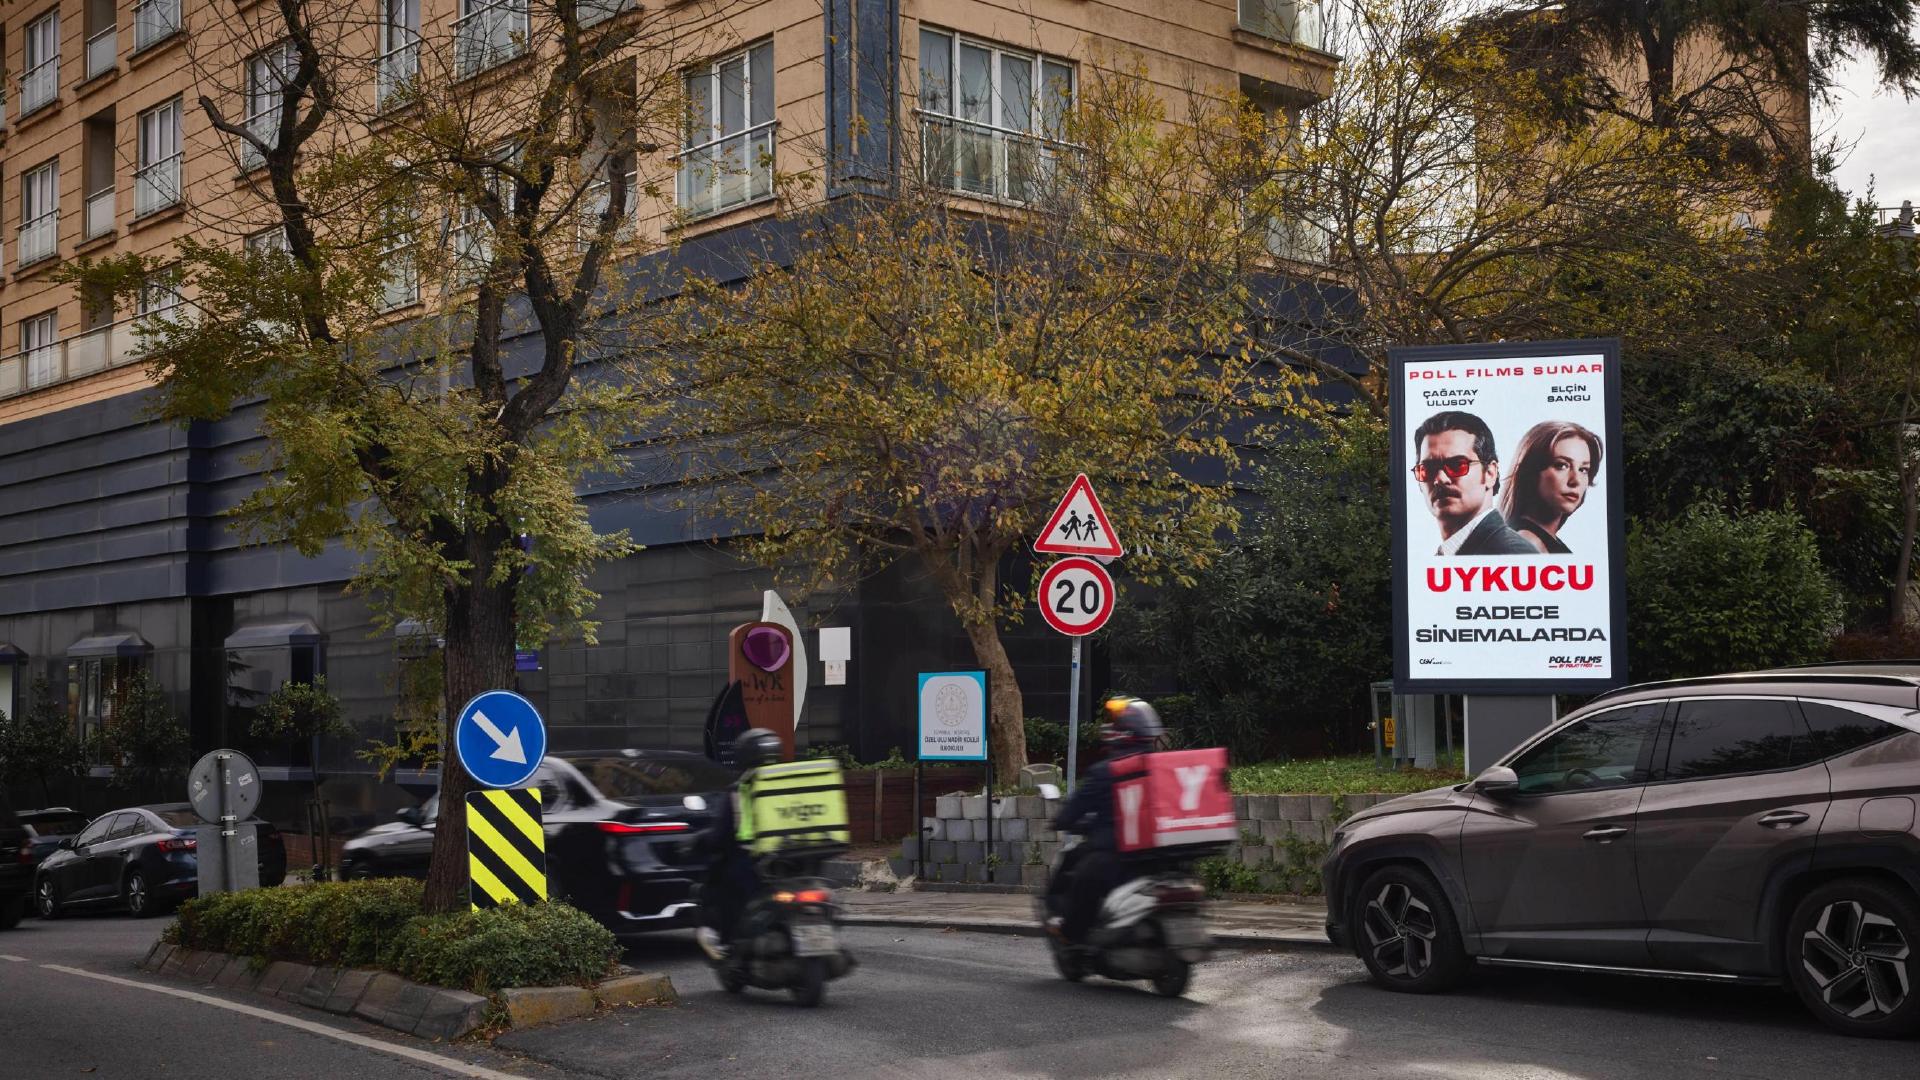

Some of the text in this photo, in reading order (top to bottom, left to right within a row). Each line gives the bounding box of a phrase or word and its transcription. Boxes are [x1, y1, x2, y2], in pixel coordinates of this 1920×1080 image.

[1409, 364, 1603, 380] POLL FILMS SUNAR
[1423, 388, 1478, 399] ÇAĞATAY
[1551, 384, 1587, 394] ELÇİN
[1426, 398, 1475, 407] ULUSOY
[1547, 394, 1591, 403] SANGU
[1426, 564, 1595, 593] UYKUCU
[1056, 580, 1099, 614] 20
[1455, 606, 1560, 620] SADECE
[1415, 624, 1607, 643] SİNEMALARDA
[1548, 656, 1603, 664] POLL FILMS
